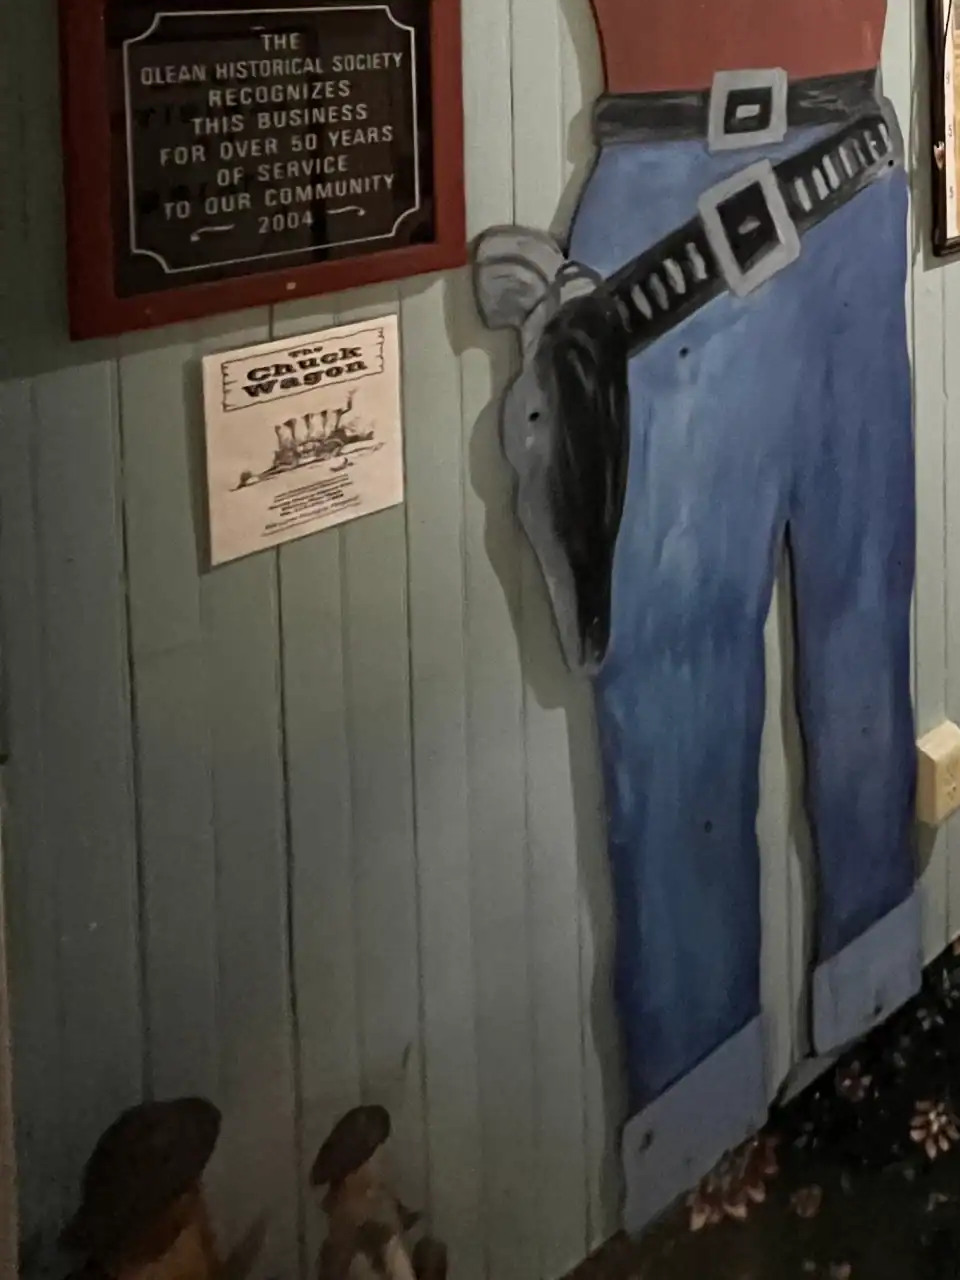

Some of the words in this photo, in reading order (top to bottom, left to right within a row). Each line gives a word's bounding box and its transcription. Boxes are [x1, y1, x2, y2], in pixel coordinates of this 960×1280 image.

[261, 32, 301, 52] THE
[140, 65, 206, 86] OLEAN
[215, 56, 324, 80] HISTORICAL
[332, 52, 404, 73] SOCIETY
[208, 79, 352, 108] RECOGNIZES
[193, 113, 245, 136] THIS
[257, 103, 369, 130] BUSINESS
[159, 145, 206, 167] FOR
[219, 137, 278, 161] OVER
[291, 133, 318, 152] 50
[328, 124, 395, 148] YEARS
[216, 165, 245, 188] OF
[257, 154, 349, 183] SERVICE
[164, 200, 191, 220] TO
[204, 192, 252, 216] OUR
[264, 173, 396, 208] COMMUNITY
[258, 209, 314, 234] 2004
[241, 360, 368, 398] Wagon
[246, 346, 363, 382] Chuck
